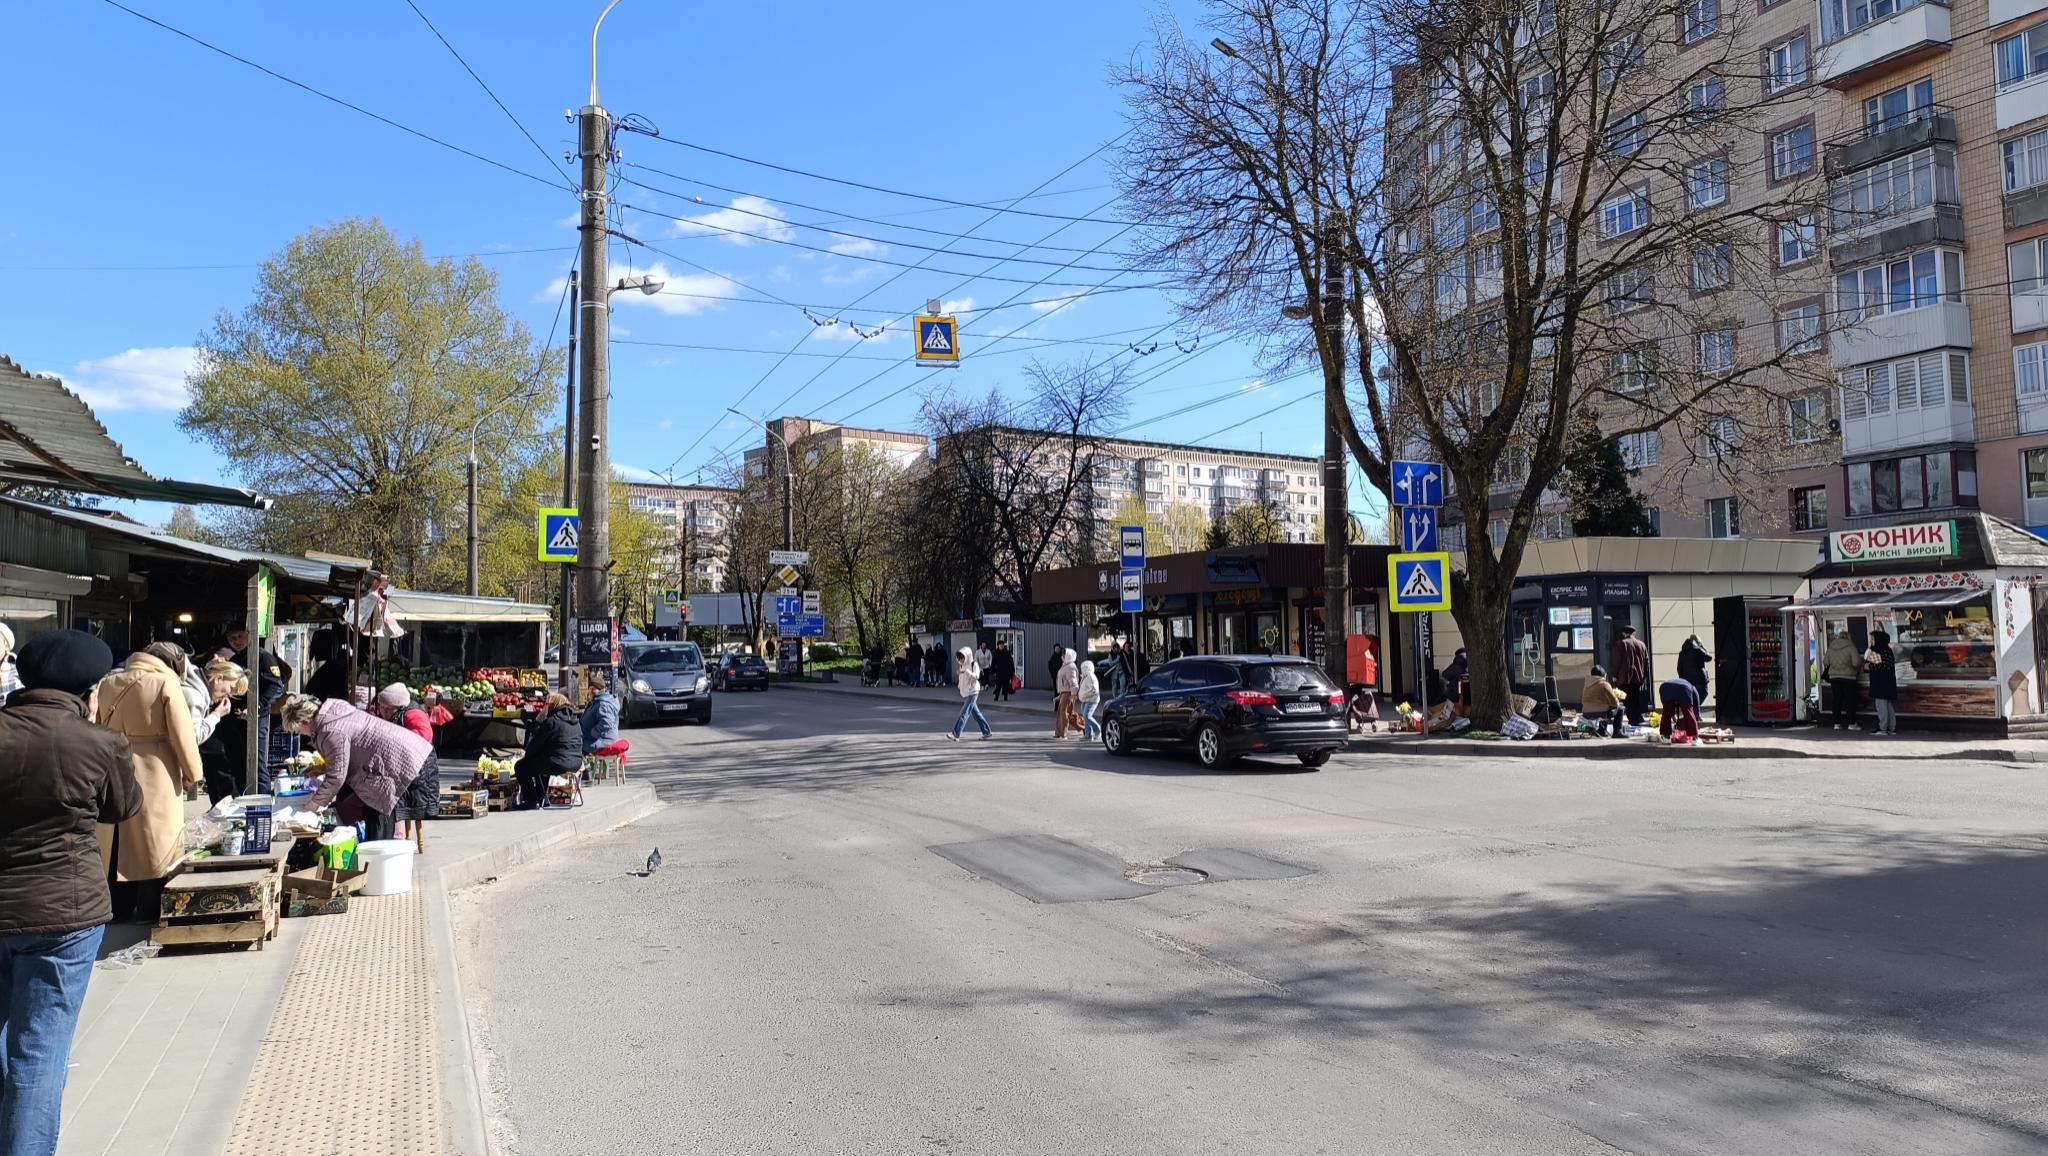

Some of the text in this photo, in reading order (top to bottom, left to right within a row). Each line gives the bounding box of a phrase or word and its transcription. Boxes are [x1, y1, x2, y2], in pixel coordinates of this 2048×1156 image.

[1868, 525, 1944, 548] ЮНИК
[1868, 545, 1945, 558] М'ЯСНІ ВИРОБИ
[580, 623, 608, 633] ШАФА
